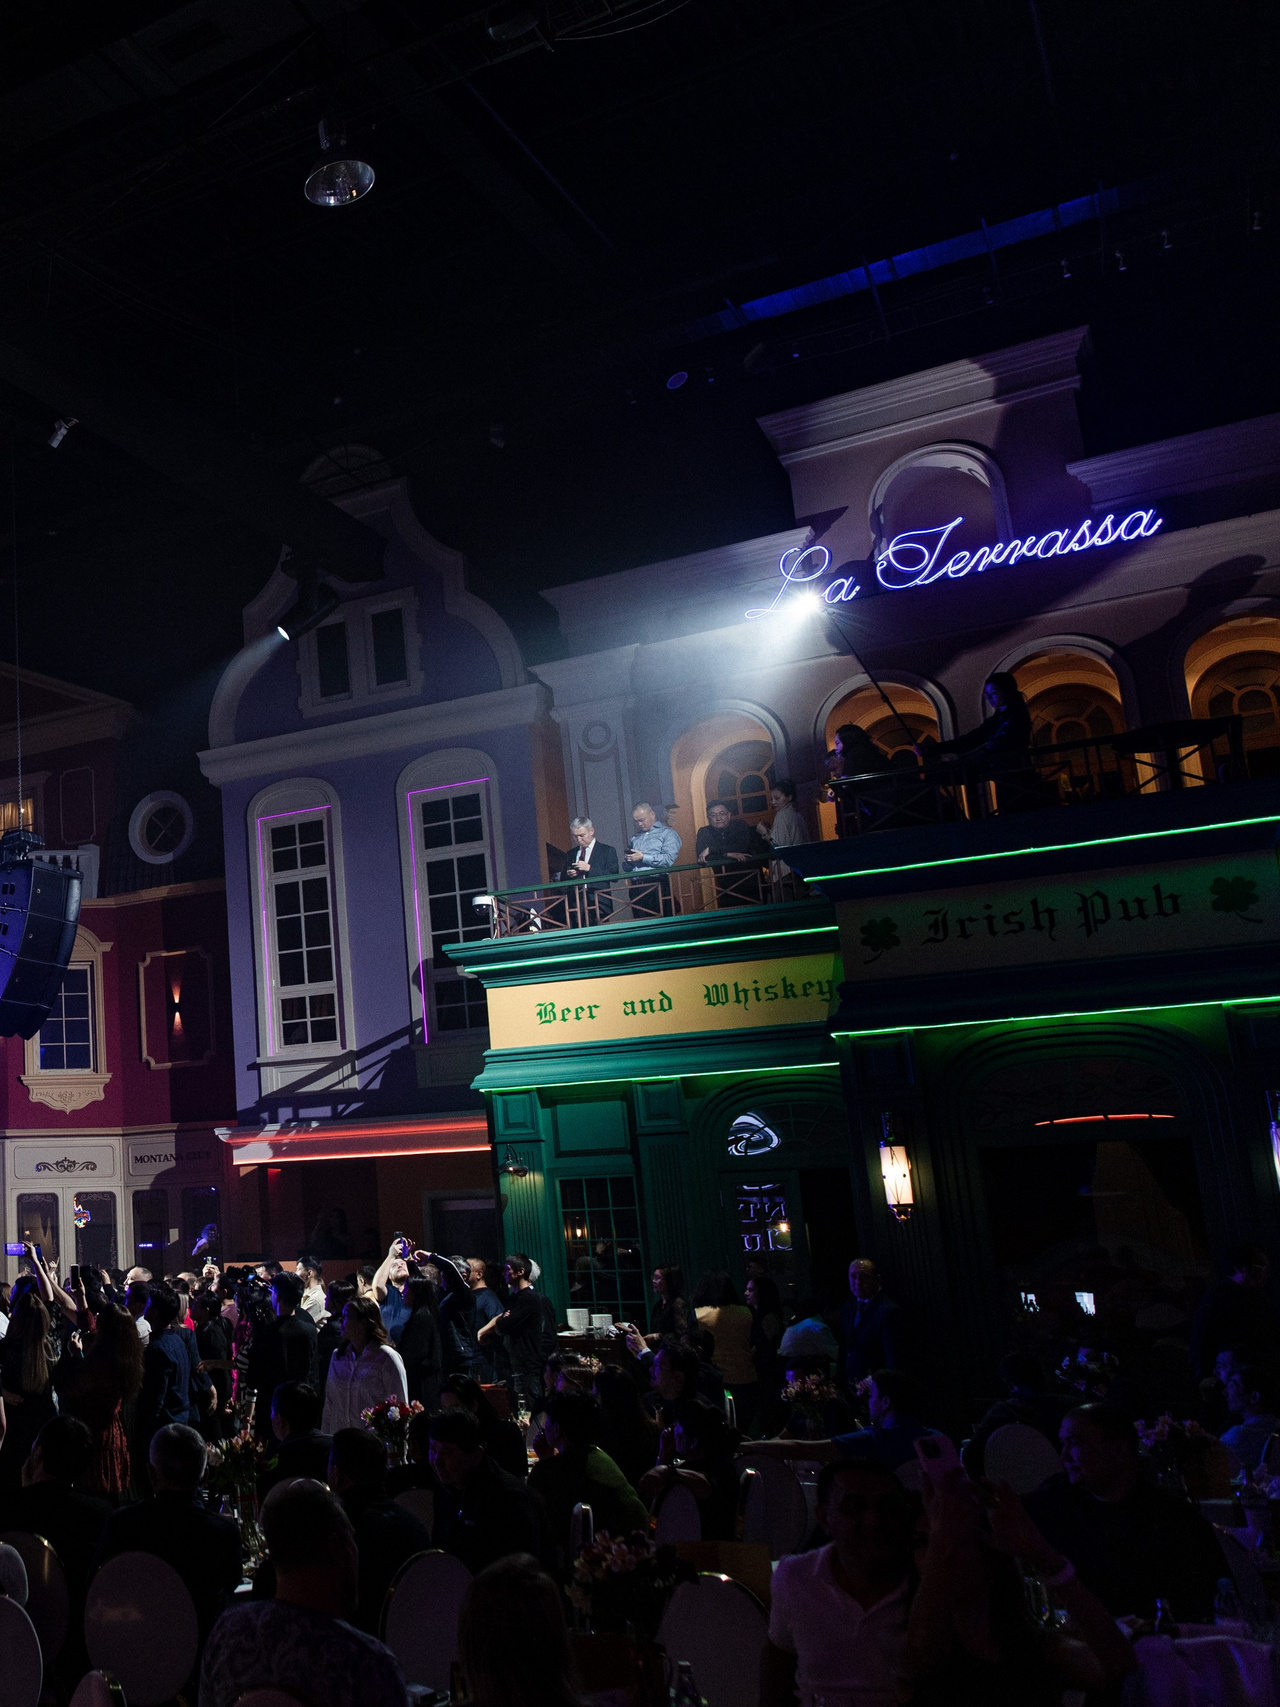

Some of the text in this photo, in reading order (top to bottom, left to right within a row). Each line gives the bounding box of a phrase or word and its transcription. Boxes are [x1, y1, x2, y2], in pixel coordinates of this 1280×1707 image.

[744, 507, 1164, 619] La Terrassa
[921, 882, 1183, 946] Irish Pub
[535, 975, 835, 1026] Beer and Whiskey
[134, 1152, 184, 1164] MONTANA
